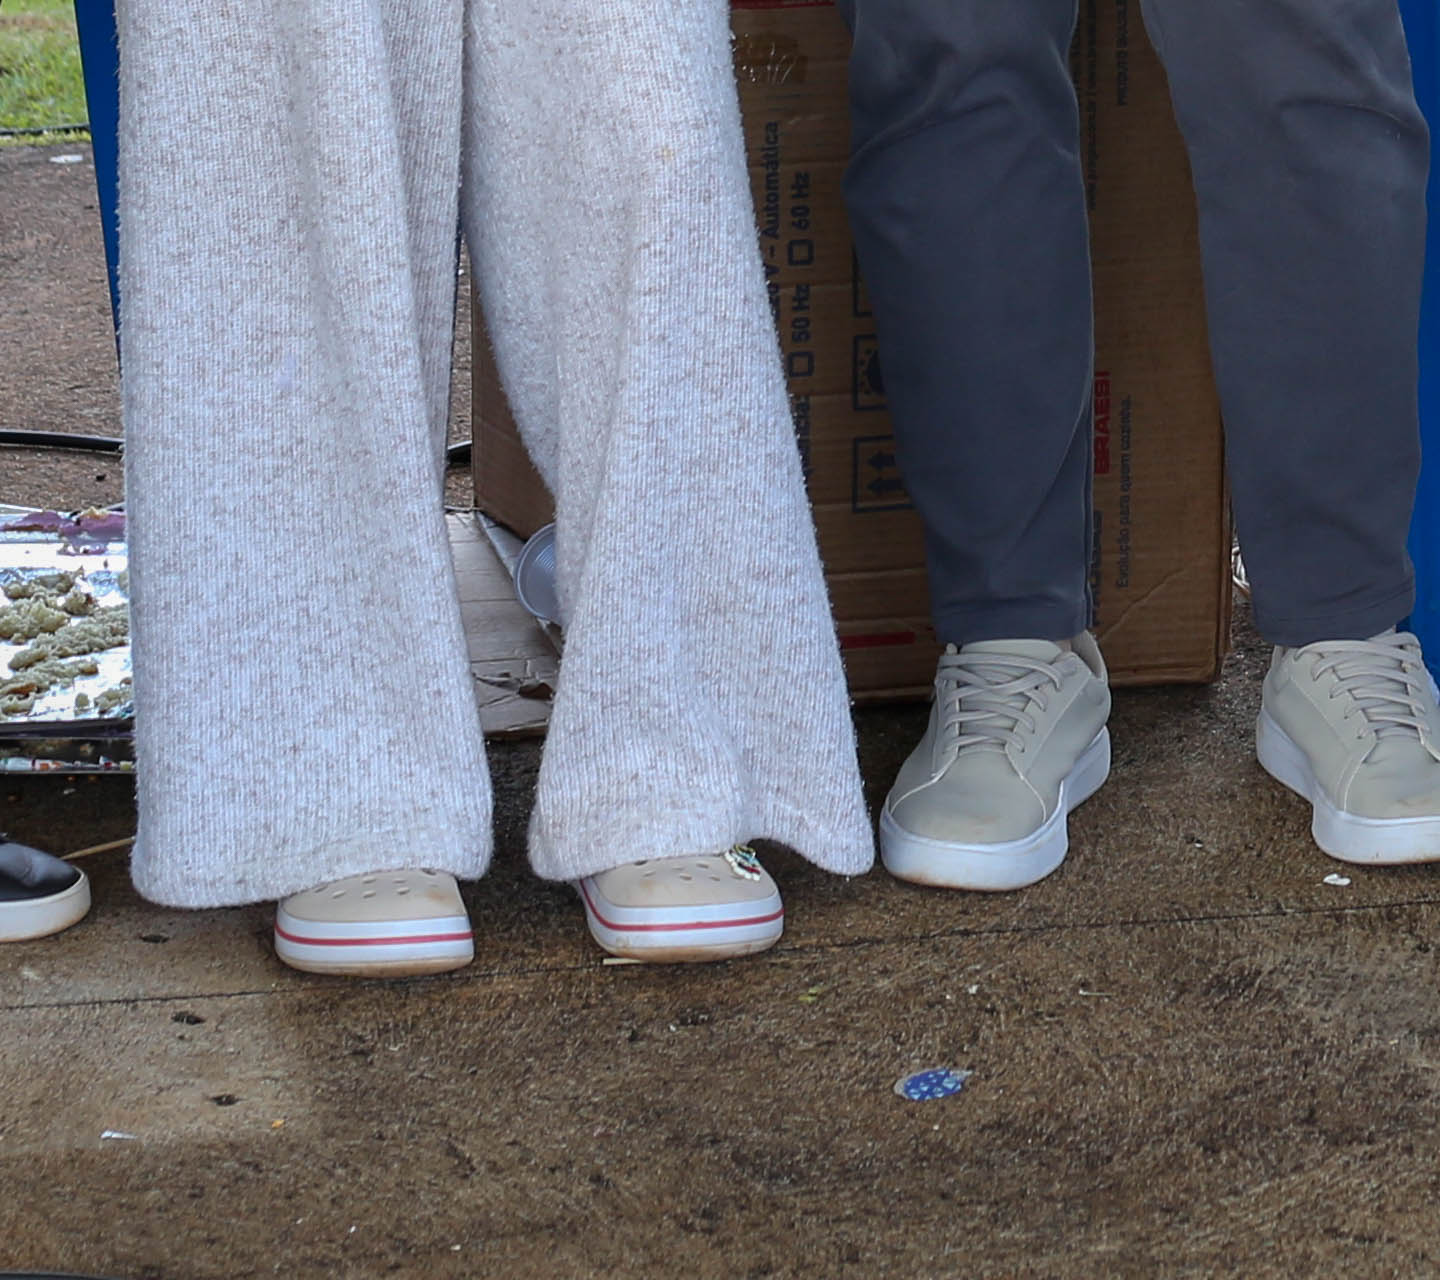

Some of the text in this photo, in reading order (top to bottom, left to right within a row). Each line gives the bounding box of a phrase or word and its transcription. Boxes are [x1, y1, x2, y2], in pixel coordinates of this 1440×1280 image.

[759, 121, 780, 239] Automática
[790, 173, 810, 230] 60 Hz
[791, 283, 810, 344] 50 Hz
